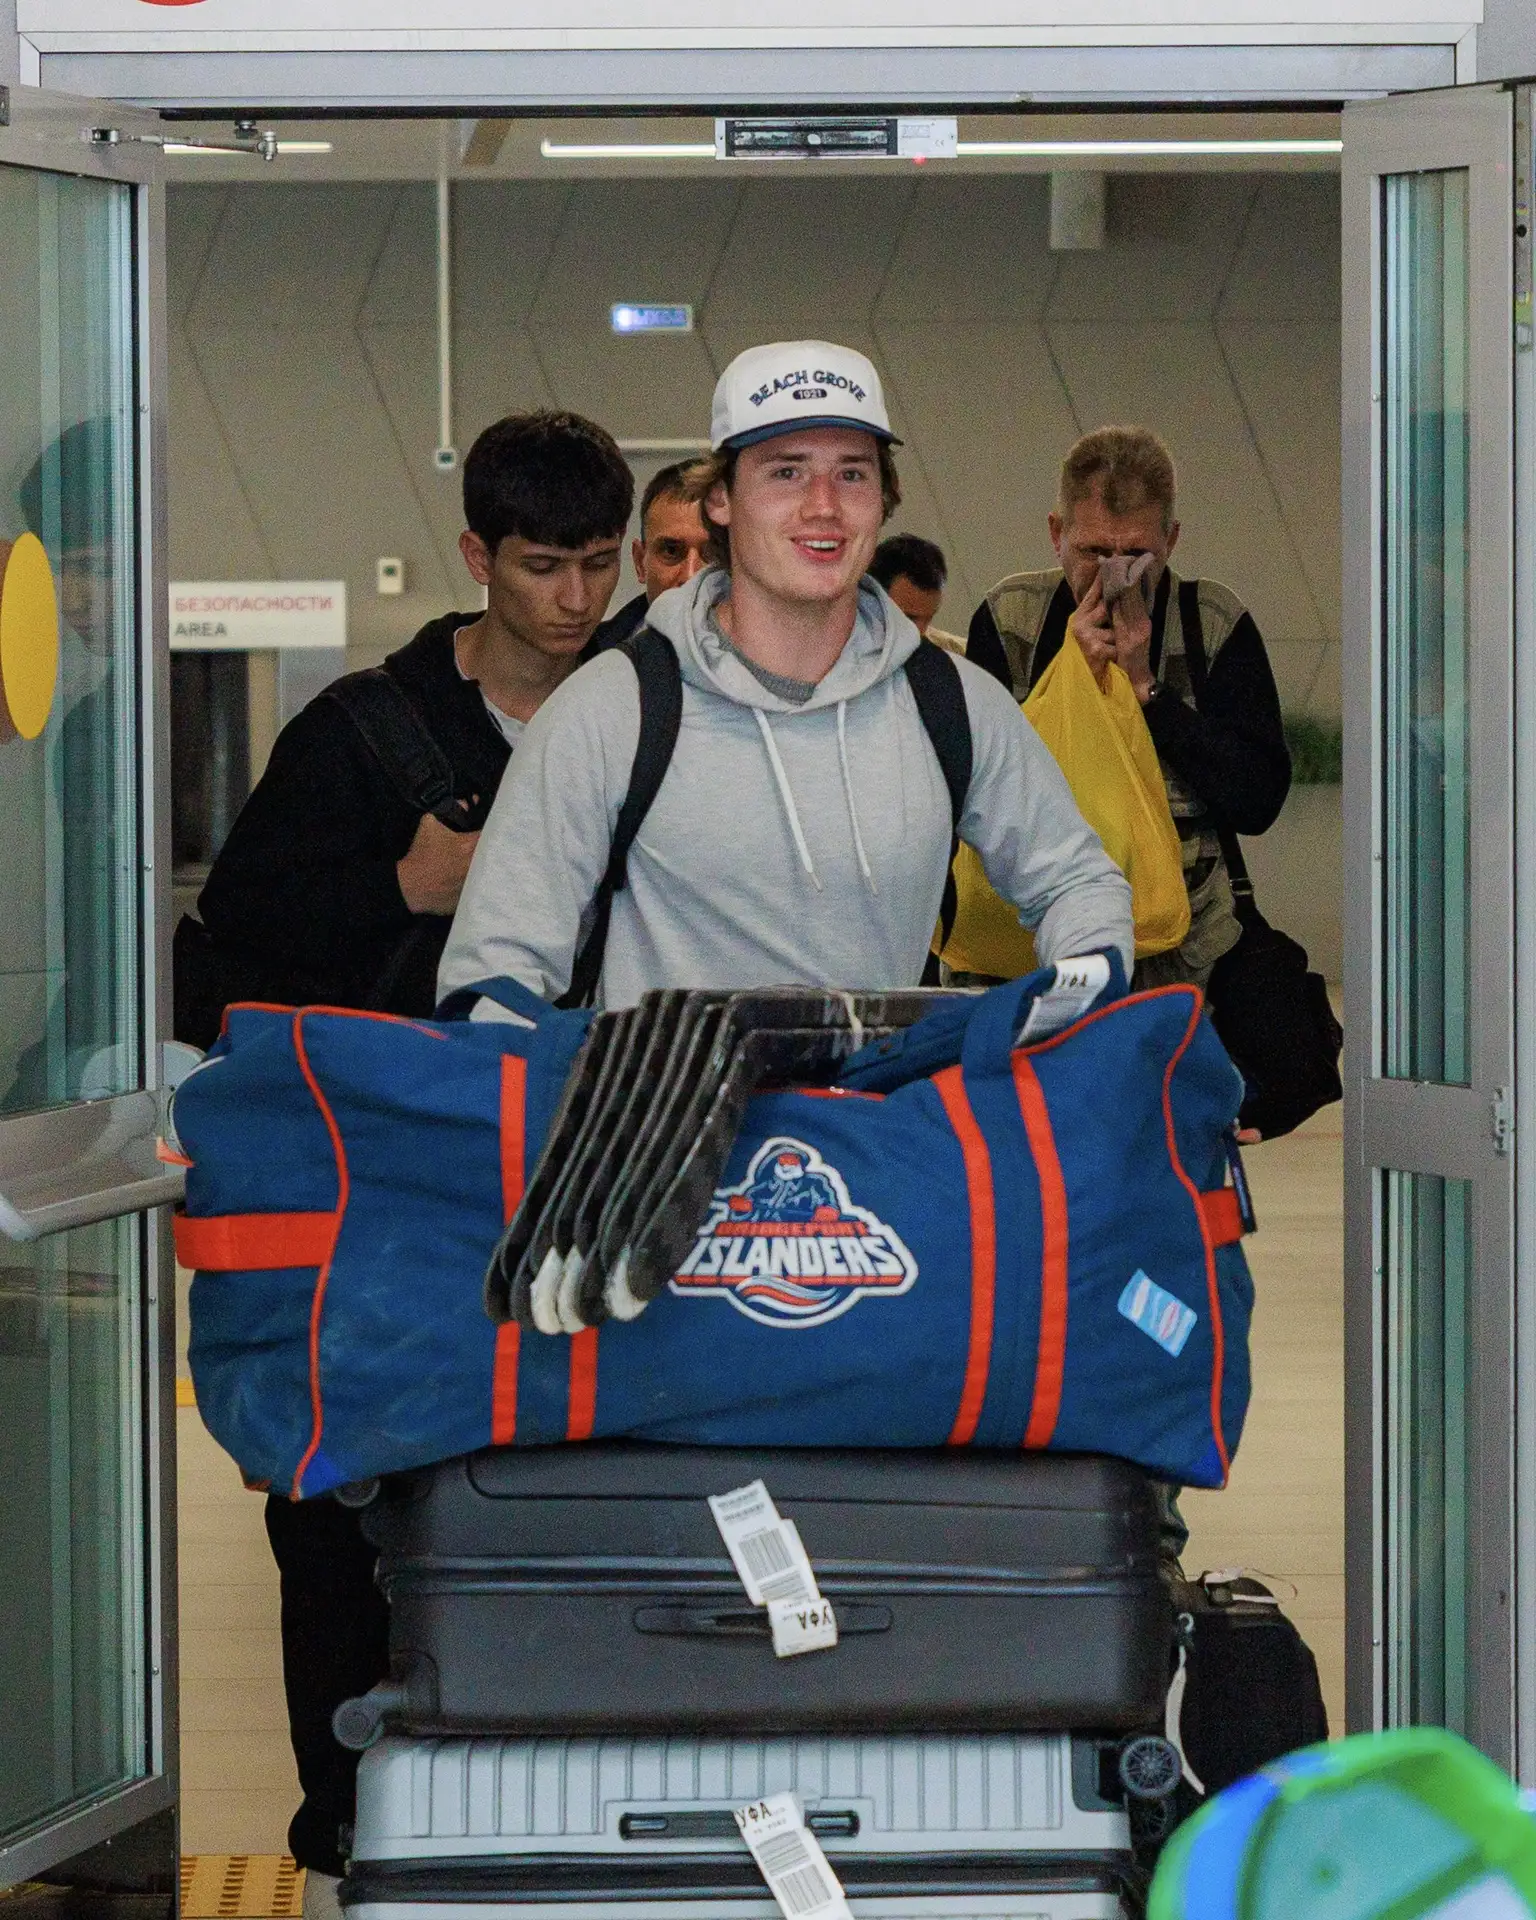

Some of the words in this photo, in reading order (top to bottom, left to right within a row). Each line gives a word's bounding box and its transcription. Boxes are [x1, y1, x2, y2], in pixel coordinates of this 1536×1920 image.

[749, 370, 808, 406] BEACH
[813, 370, 866, 402] GROVE
[797, 389, 823, 399] 1921
[175, 596, 333, 612] БЕЗОПАСНОСТИ
[175, 622, 228, 636] AREA
[675, 1236, 905, 1276] ISLANDERS
[799, 1606, 832, 1630] УФА
[734, 1802, 771, 1828] УФА
